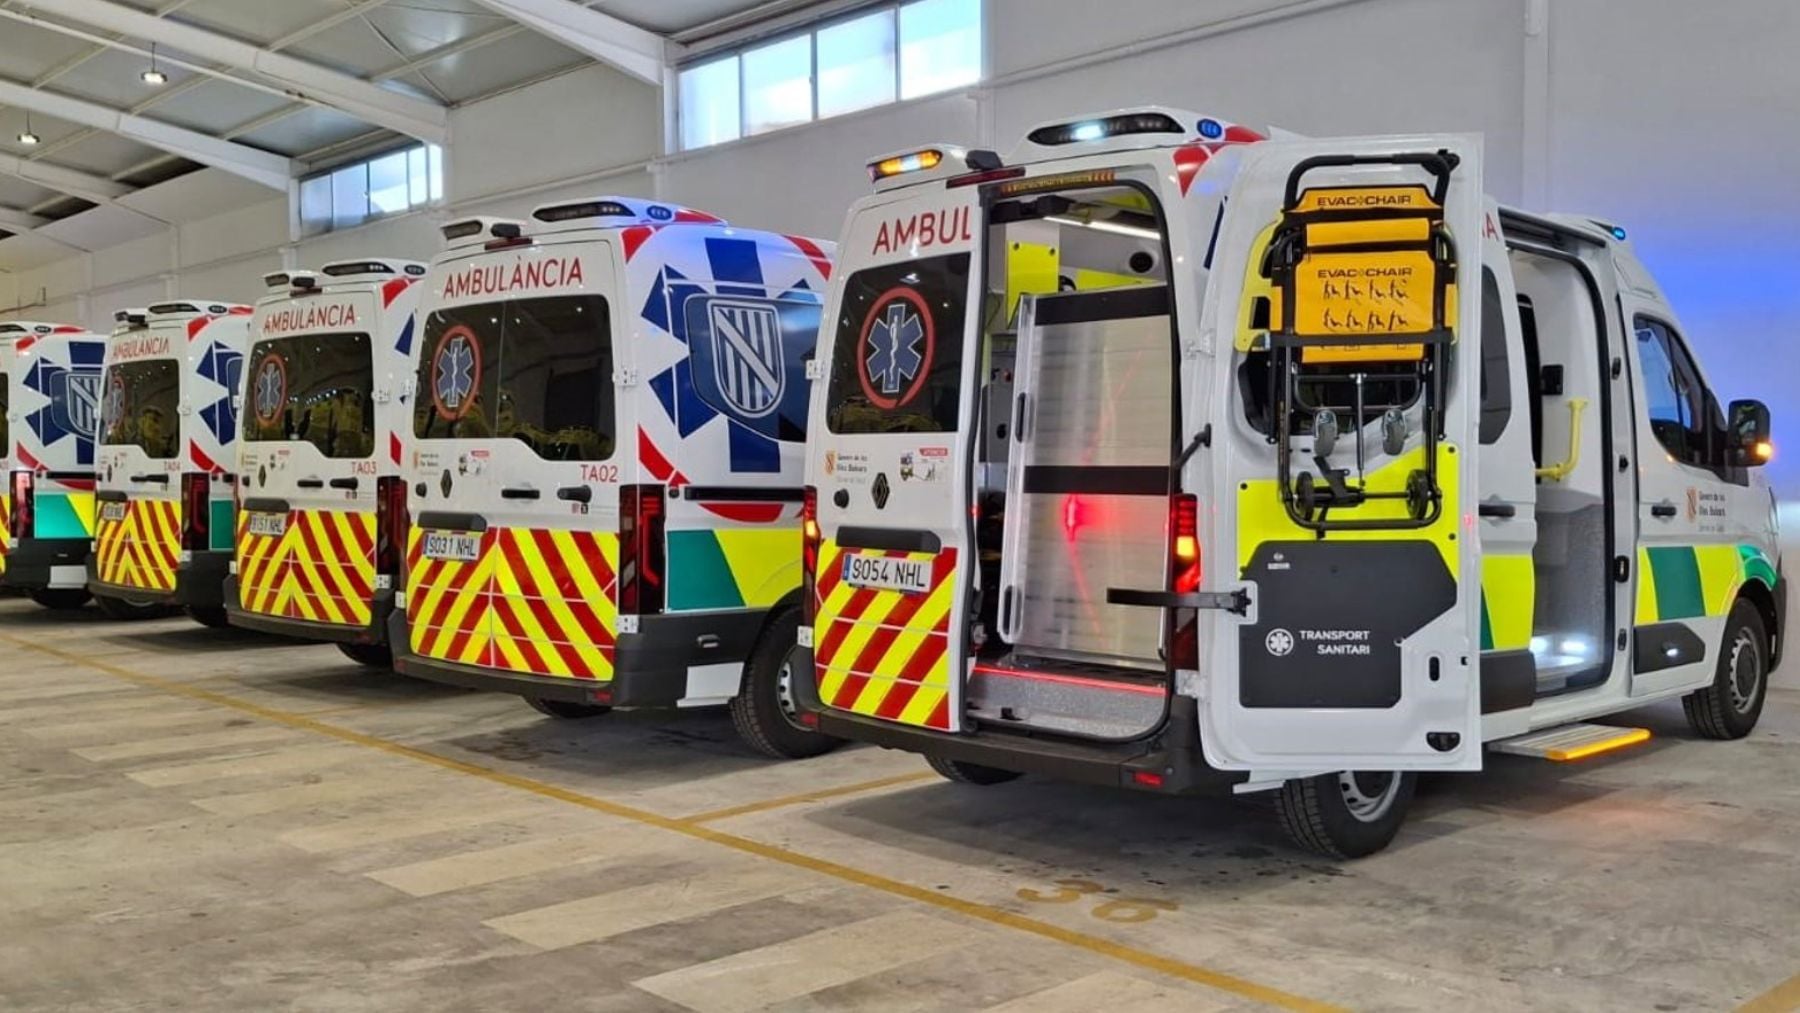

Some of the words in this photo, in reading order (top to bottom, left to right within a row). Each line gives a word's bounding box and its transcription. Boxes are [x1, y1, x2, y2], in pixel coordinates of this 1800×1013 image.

[1364, 195, 1411, 205] CHAIR
[872, 205, 971, 255] AMBUL
[443, 255, 582, 299] AMBULÀNCIA
[1365, 267, 1412, 277] CHAIR
[263, 301, 356, 333] AMBULÀNCIA
[351, 461, 377, 475] TA03
[580, 464, 618, 483] TA02
[455, 537, 476, 556] NHL
[852, 558, 889, 583] 9054
[894, 562, 926, 588] NHL
[1299, 630, 1370, 641] TRANSPORT
[1316, 644, 1370, 655] SANITARI
